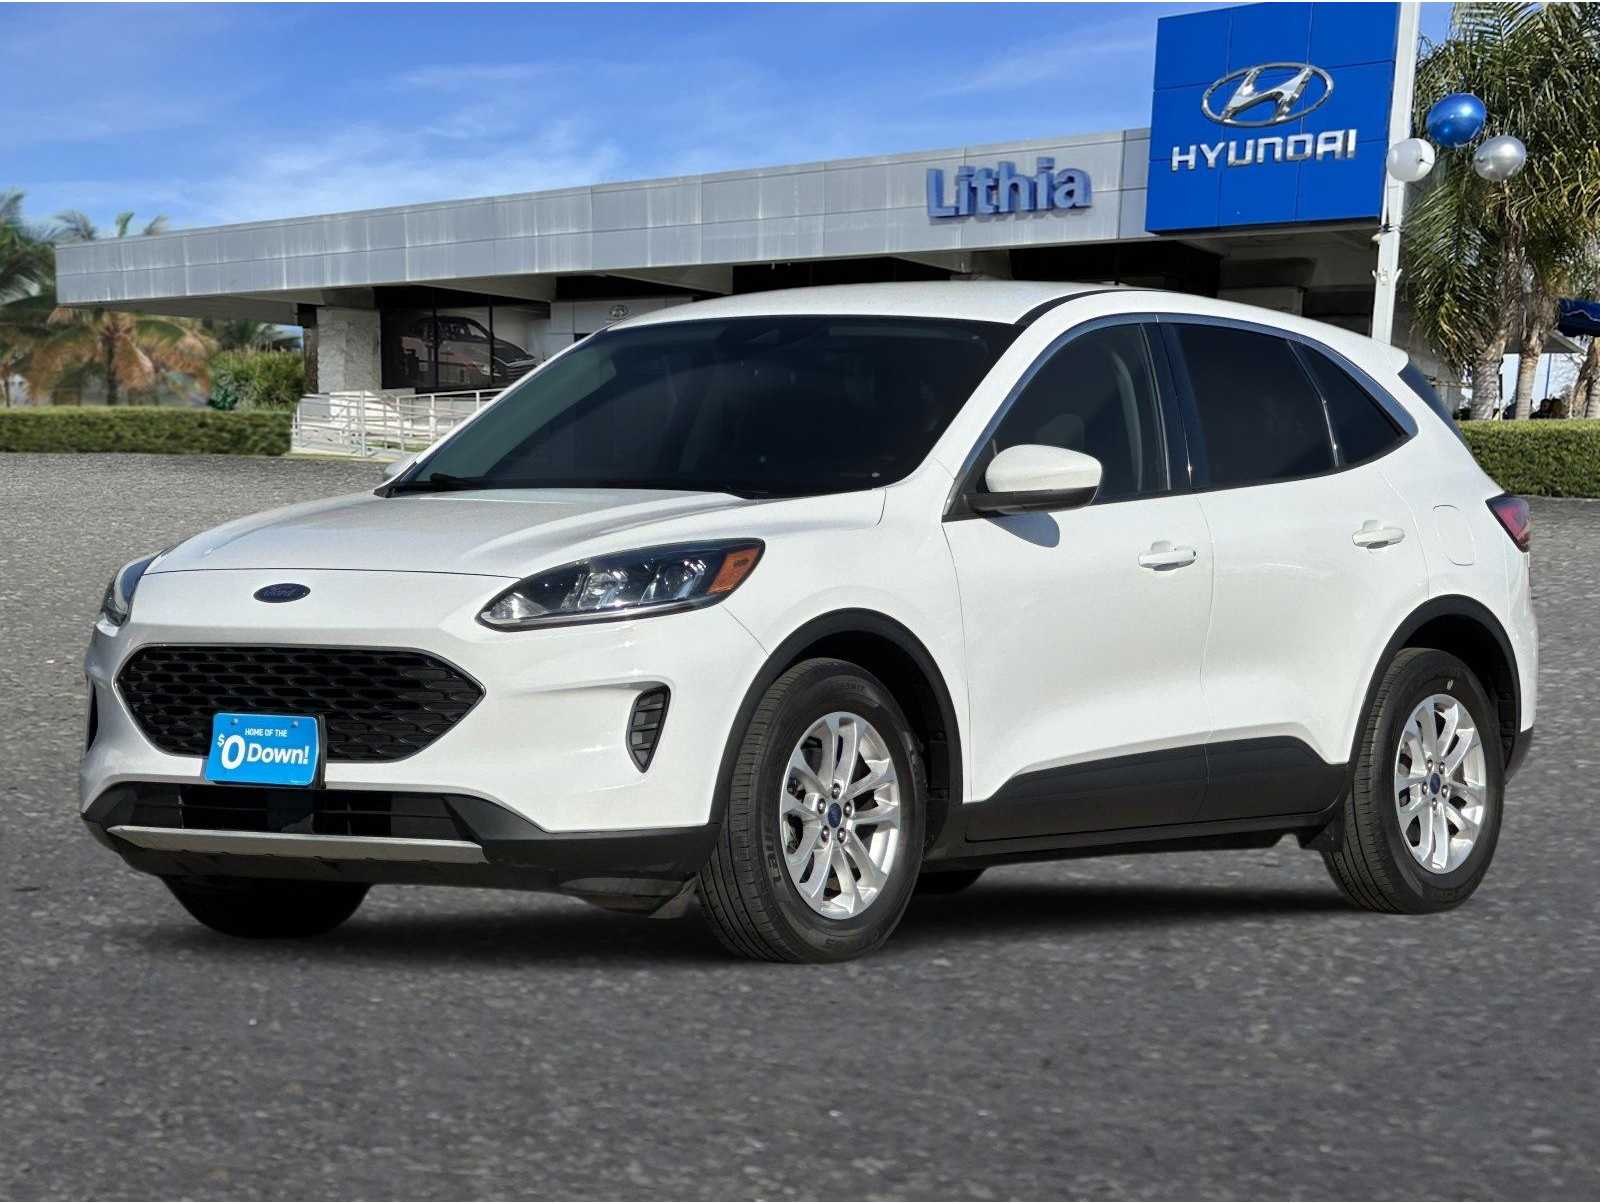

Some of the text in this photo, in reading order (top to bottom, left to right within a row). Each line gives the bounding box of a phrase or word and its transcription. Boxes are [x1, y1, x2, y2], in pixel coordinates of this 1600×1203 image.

[1171, 128, 1357, 171] HYUNDAI
[926, 156, 1093, 218] Lithia
[244, 727, 288, 738] HOME OF THE
[246, 742, 310, 765] Down!
